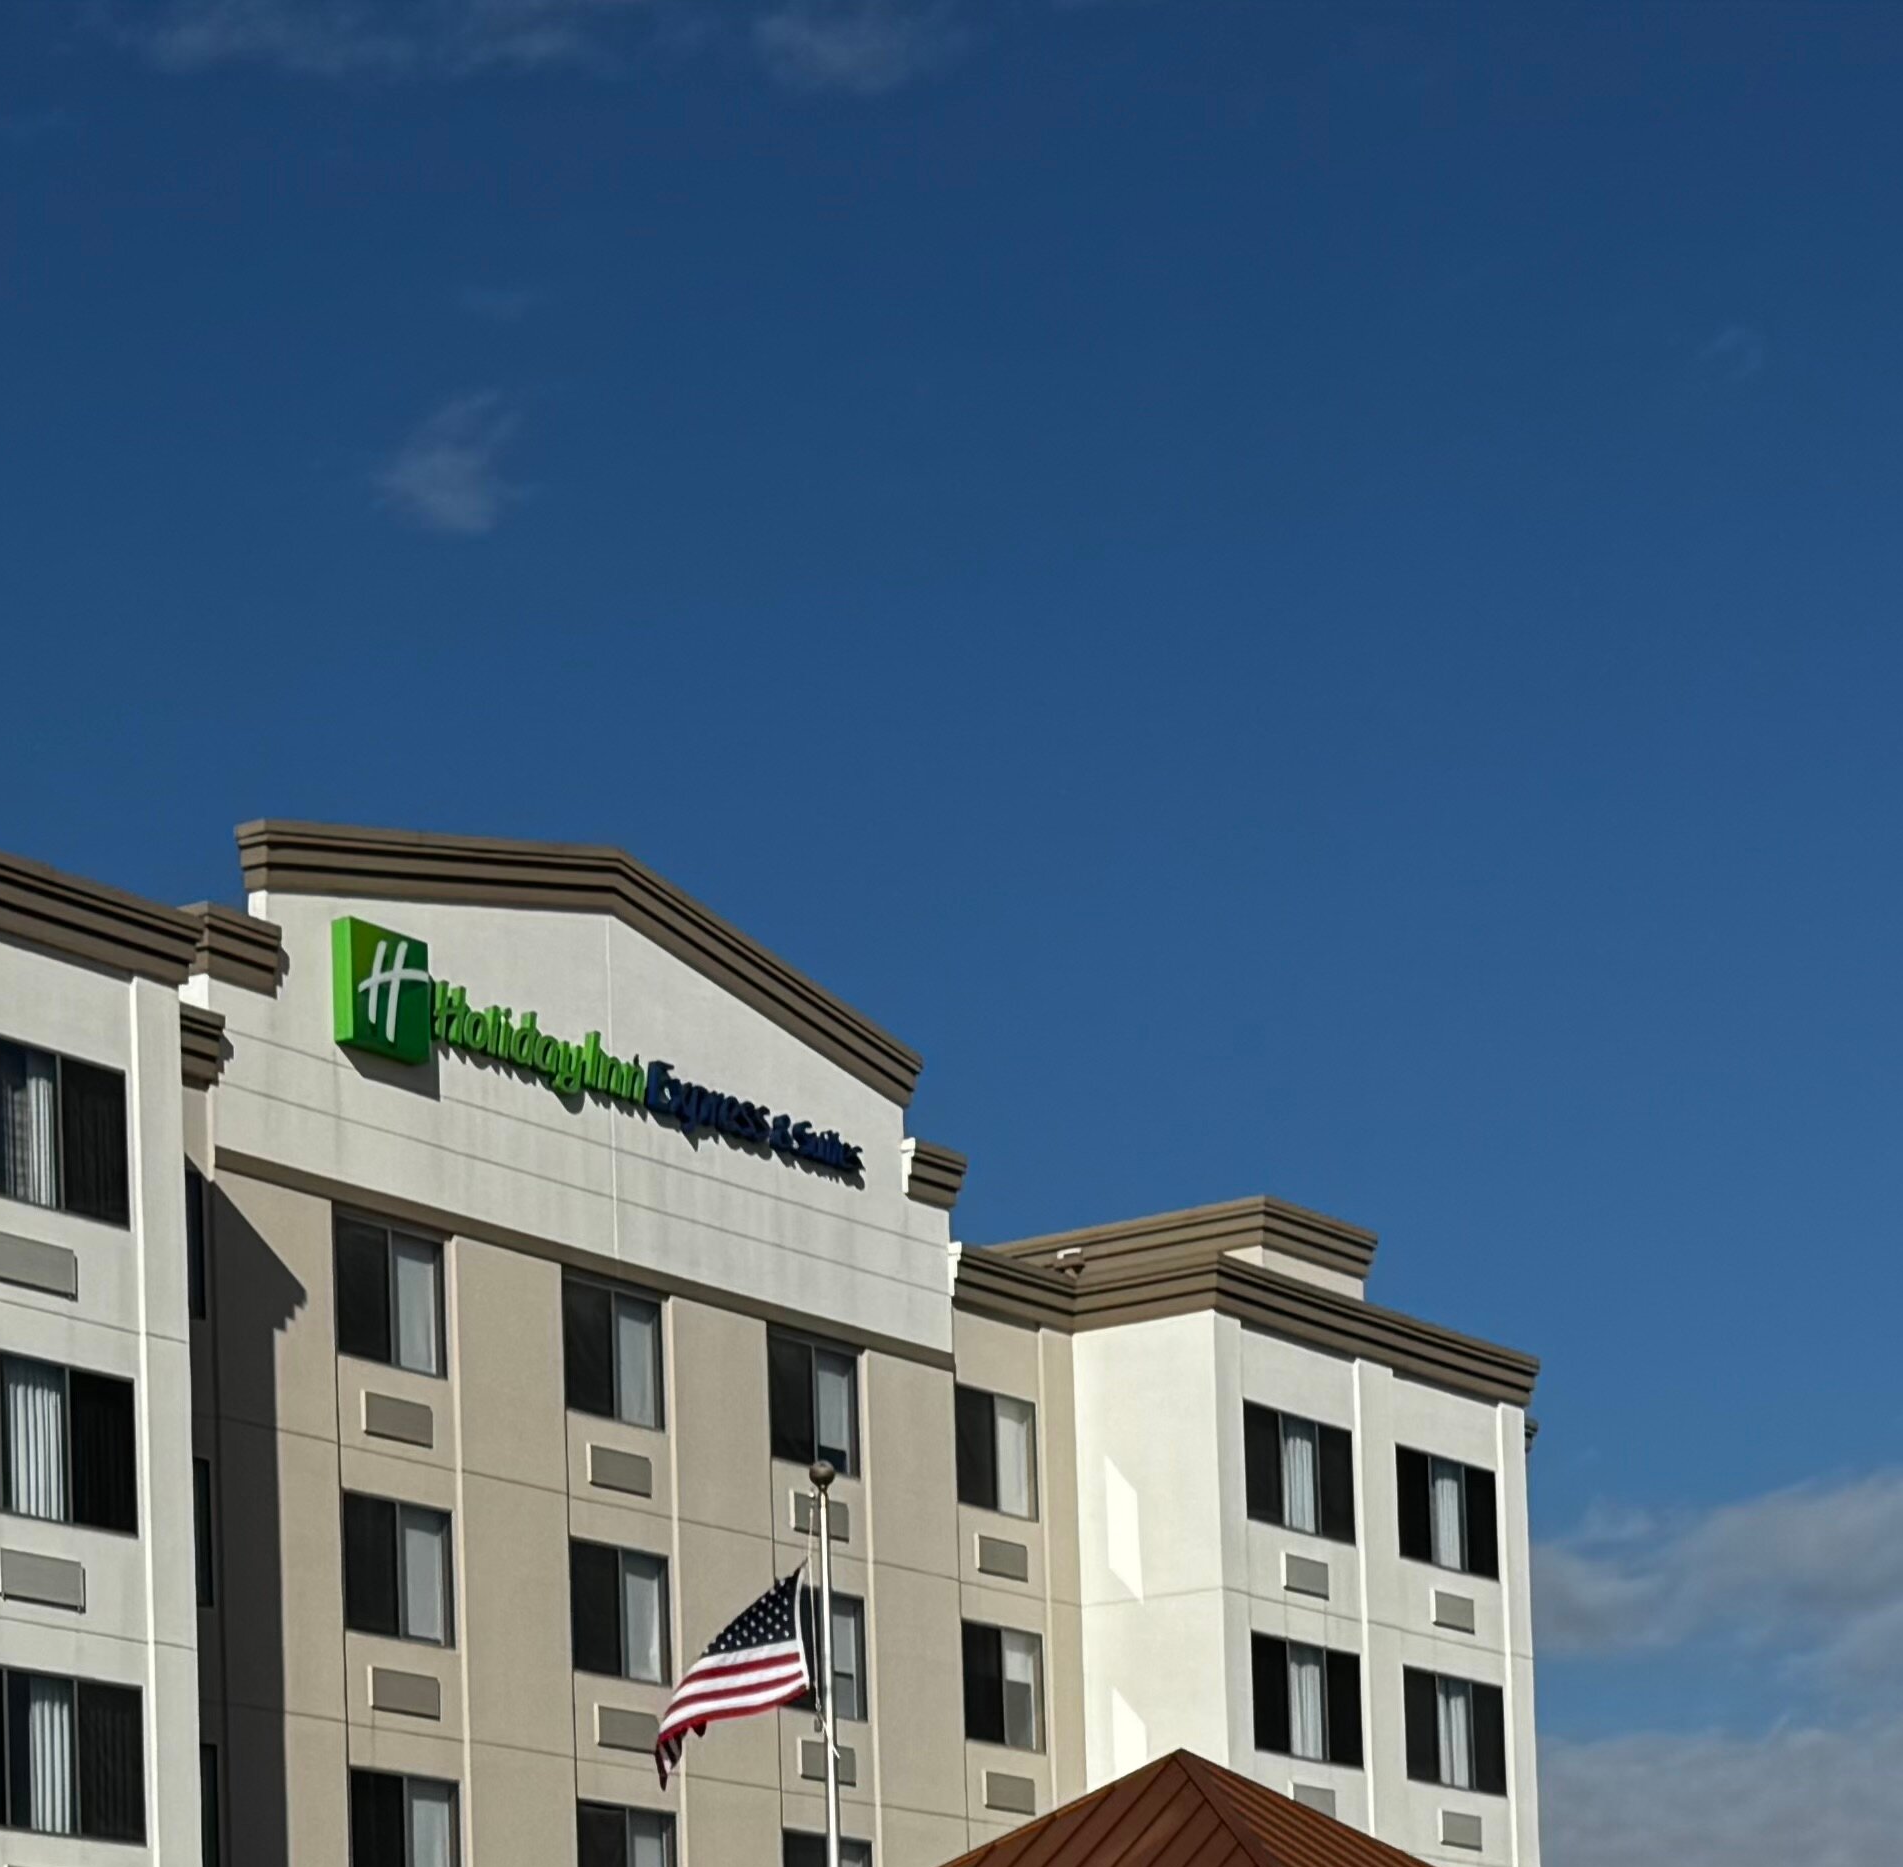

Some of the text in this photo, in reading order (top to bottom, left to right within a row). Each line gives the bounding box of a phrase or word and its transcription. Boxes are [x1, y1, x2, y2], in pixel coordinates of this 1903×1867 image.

[433, 980, 866, 1173] Holiday Inn Express & Suites
